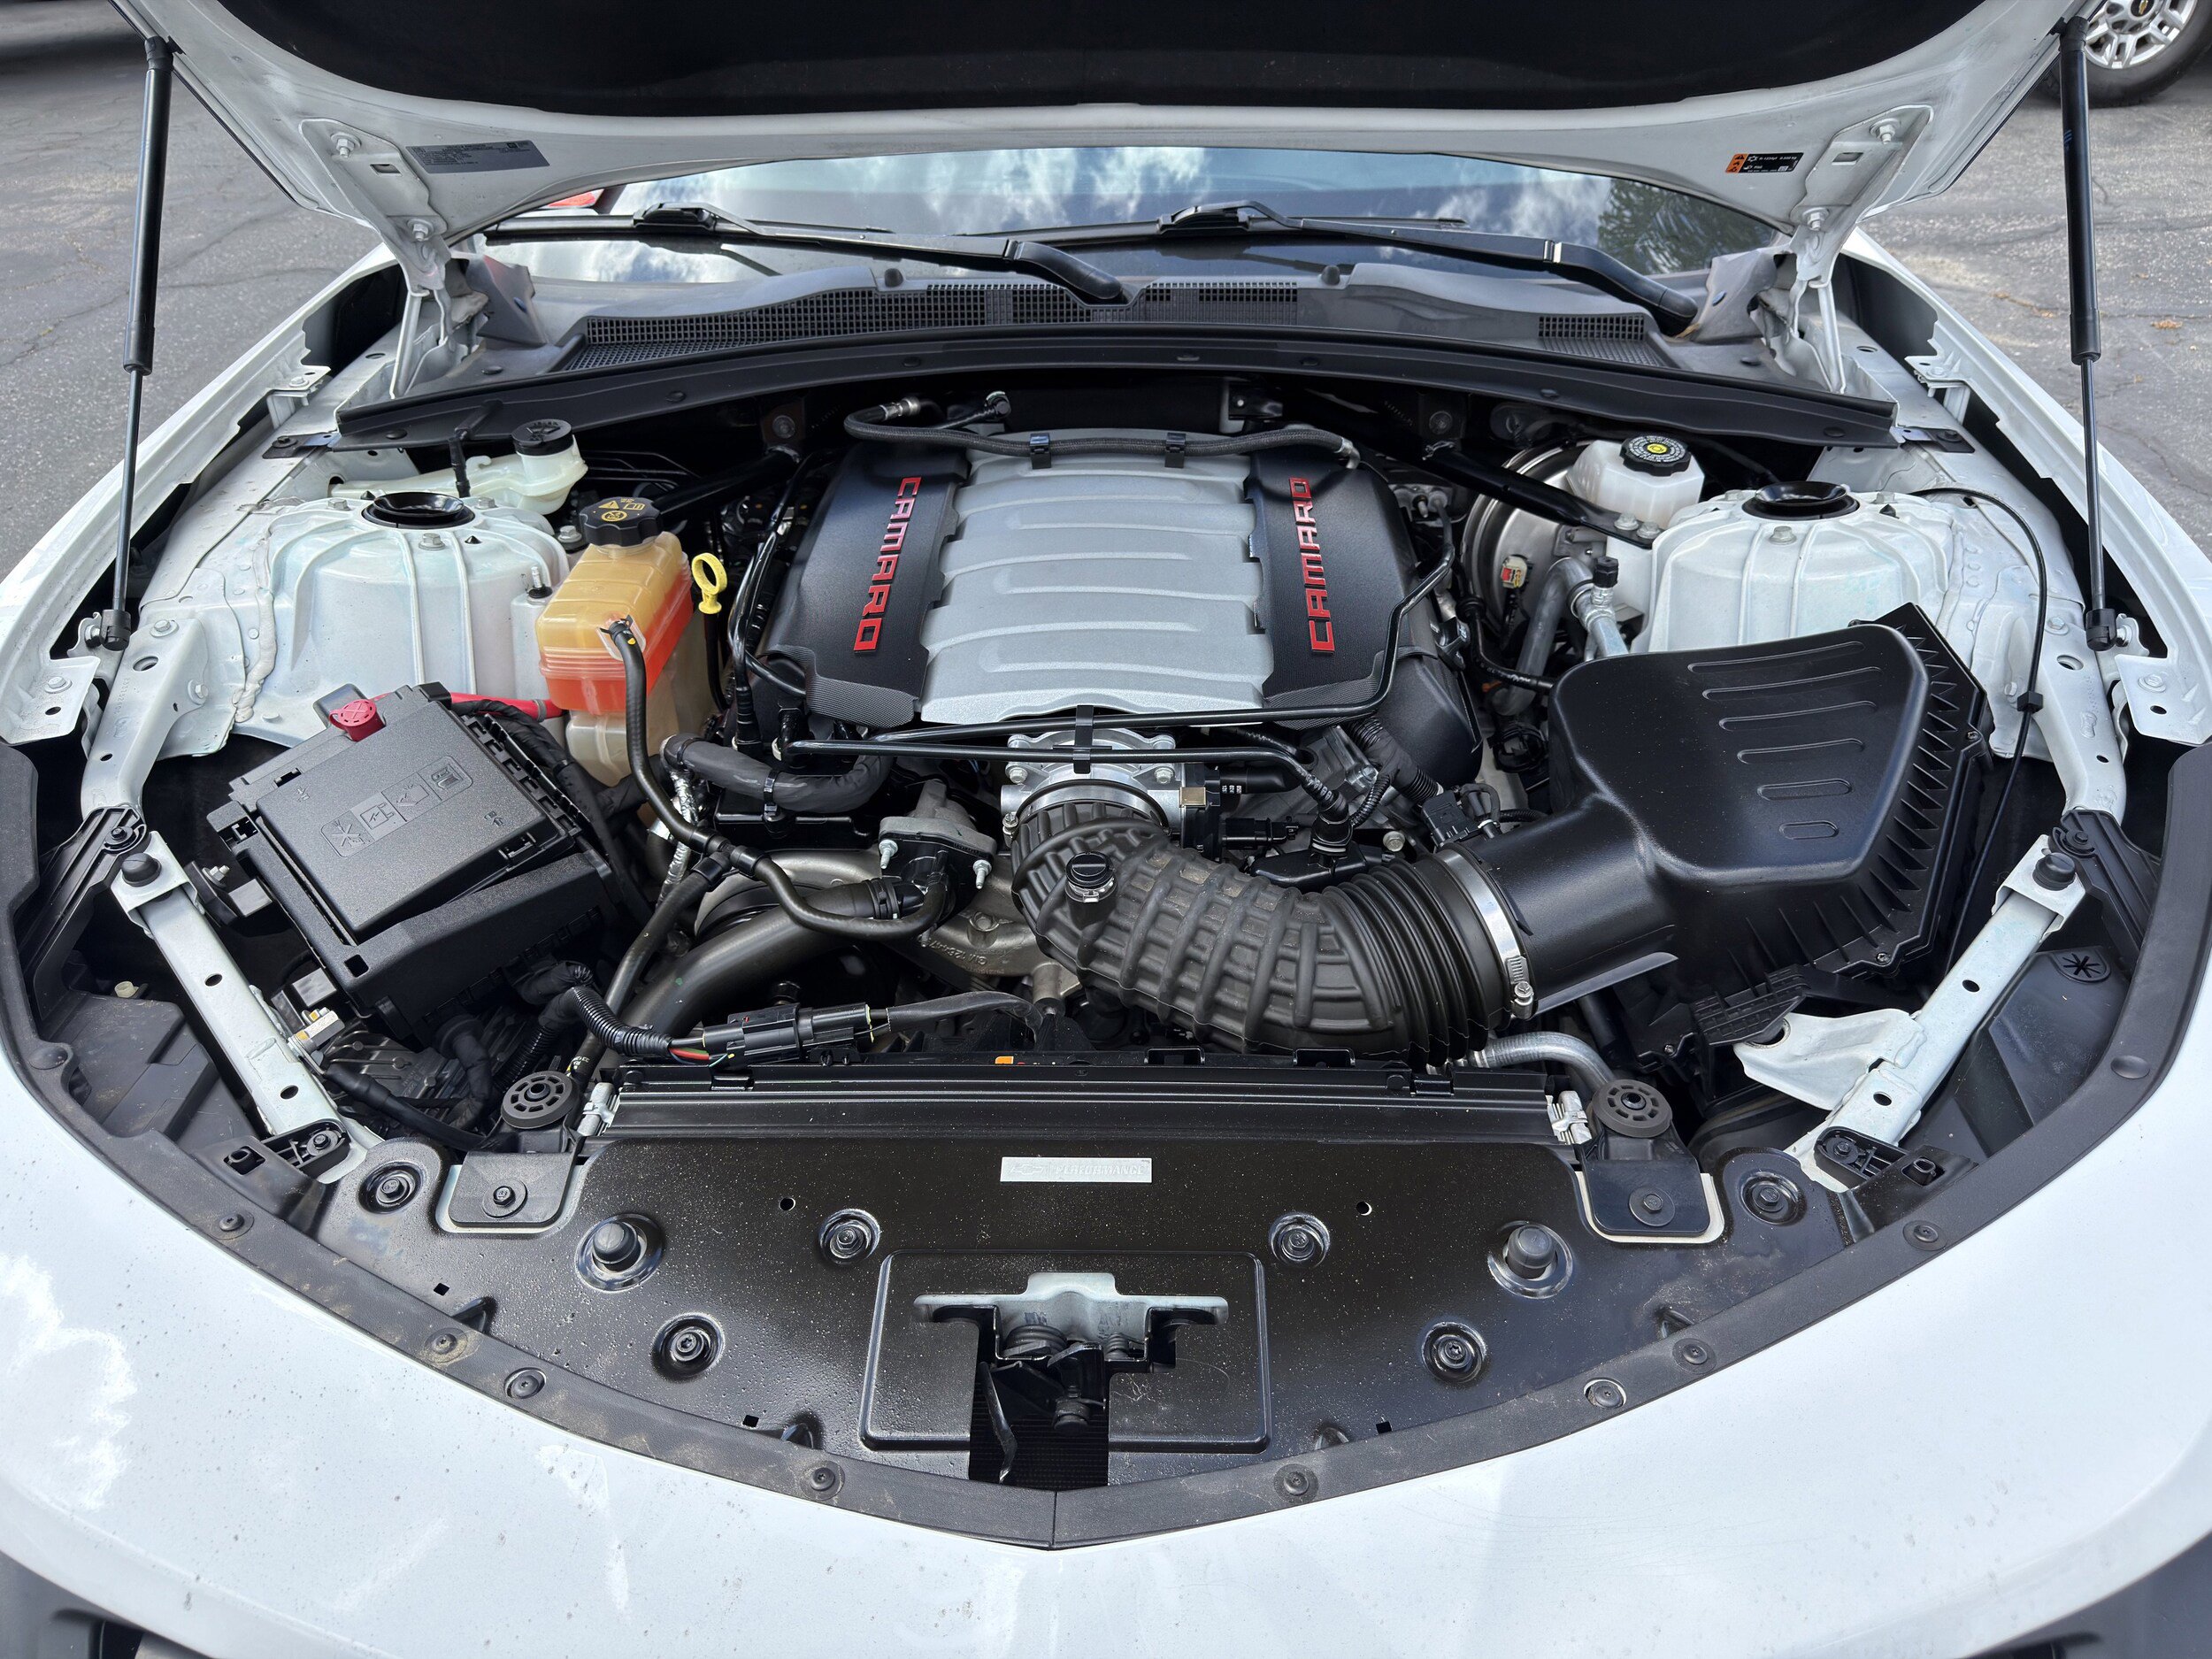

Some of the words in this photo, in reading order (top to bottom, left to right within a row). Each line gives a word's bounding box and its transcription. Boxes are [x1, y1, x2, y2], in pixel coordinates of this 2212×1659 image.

[854, 477, 922, 651] CAMARO
[1289, 477, 1335, 651] CAMARO
[1055, 1164, 1146, 1176] PERFORMANCE
